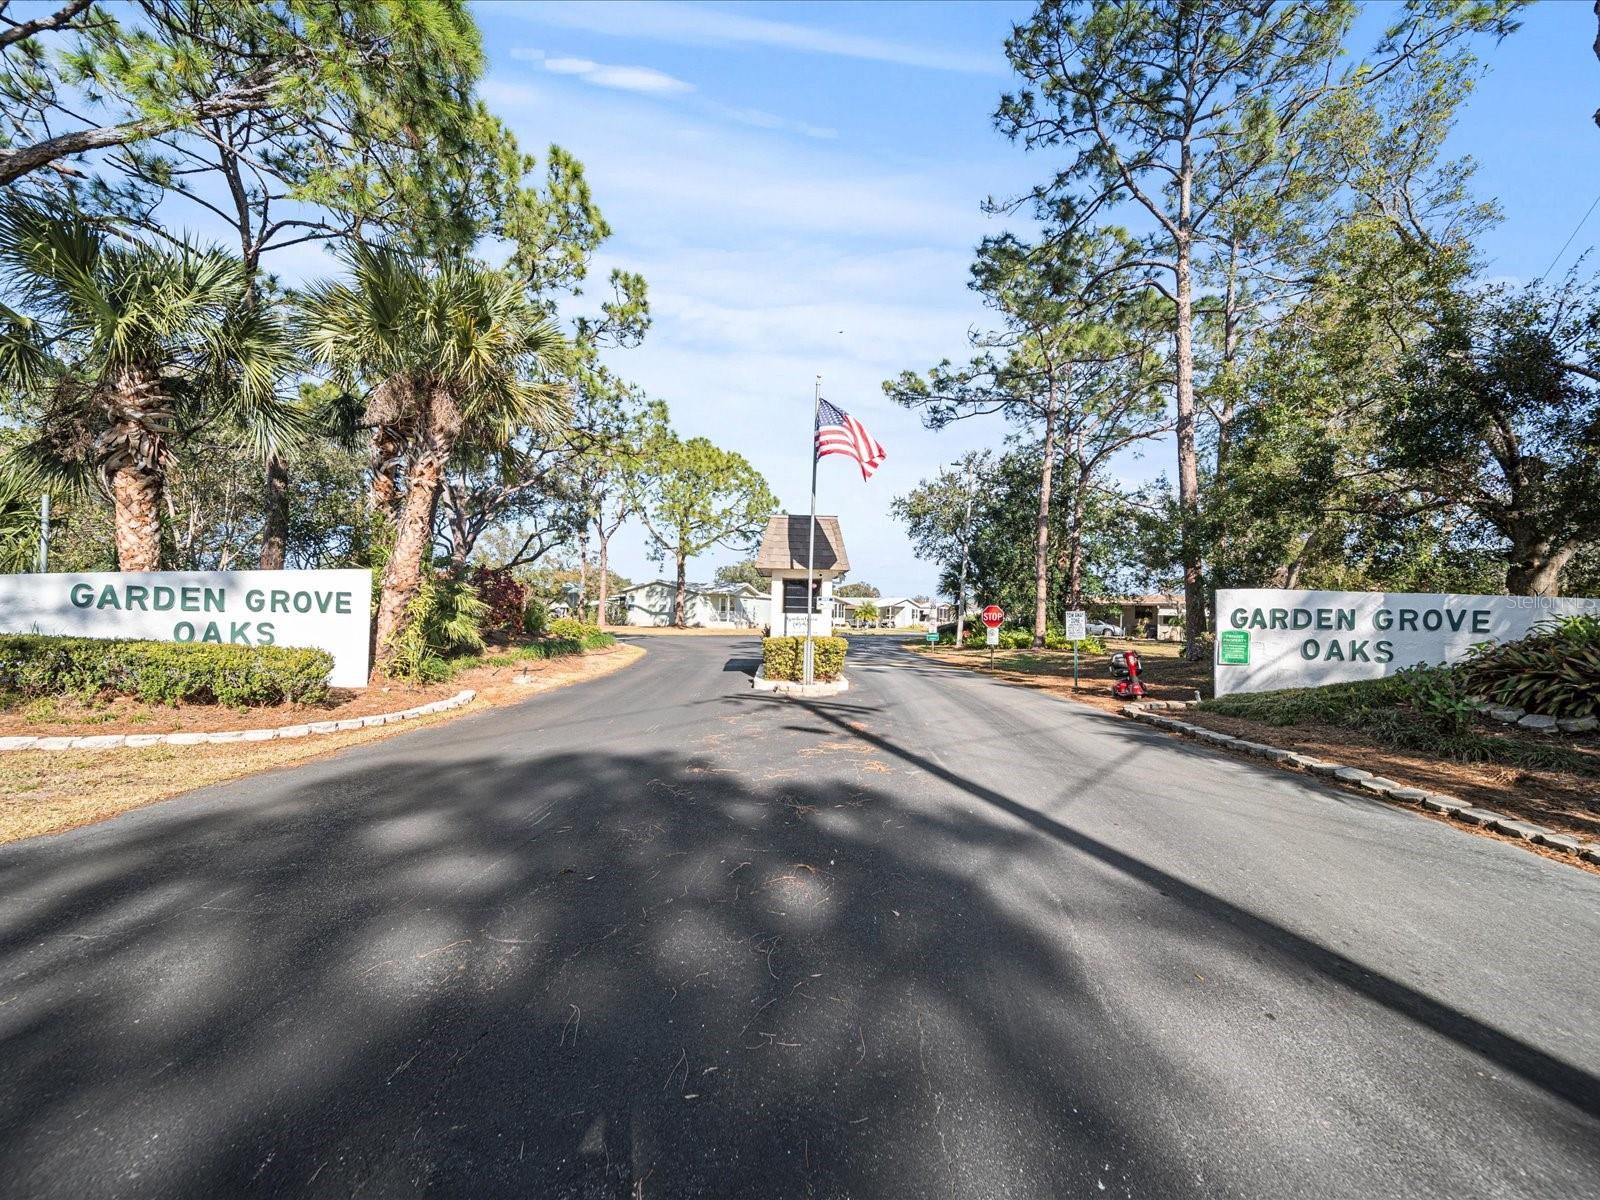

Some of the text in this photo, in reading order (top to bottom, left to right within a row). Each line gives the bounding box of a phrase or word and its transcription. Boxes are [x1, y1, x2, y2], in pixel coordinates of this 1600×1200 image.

[70, 583, 352, 614] GARDEN GROVE
[983, 612, 1003, 621] STOP
[1230, 607, 1491, 634] GARDEN GROVE
[173, 621, 275, 646] OAKS
[1300, 638, 1394, 664] OAKS
